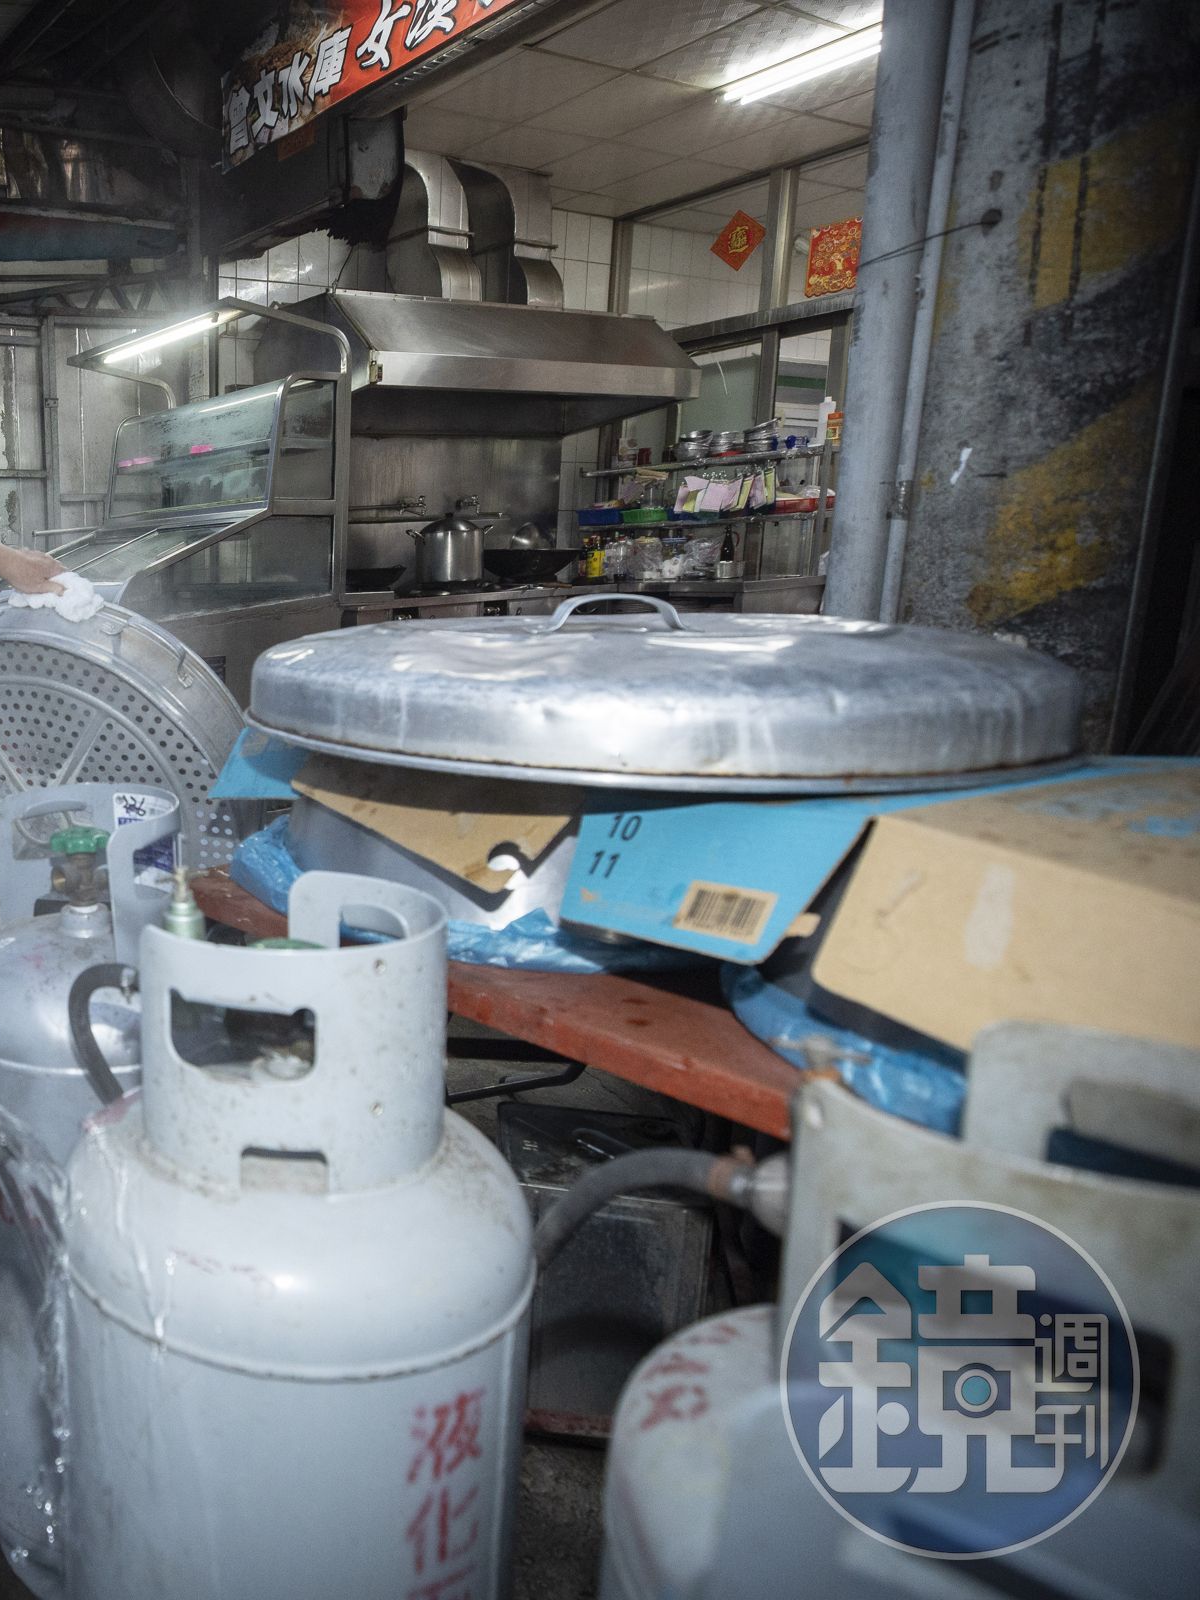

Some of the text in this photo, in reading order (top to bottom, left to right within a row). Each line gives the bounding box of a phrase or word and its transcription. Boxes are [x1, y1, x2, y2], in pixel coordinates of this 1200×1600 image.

[229, 24, 353, 154] 曾文水庫
[608, 813, 642, 842] 10
[588, 850, 620, 879] 11
